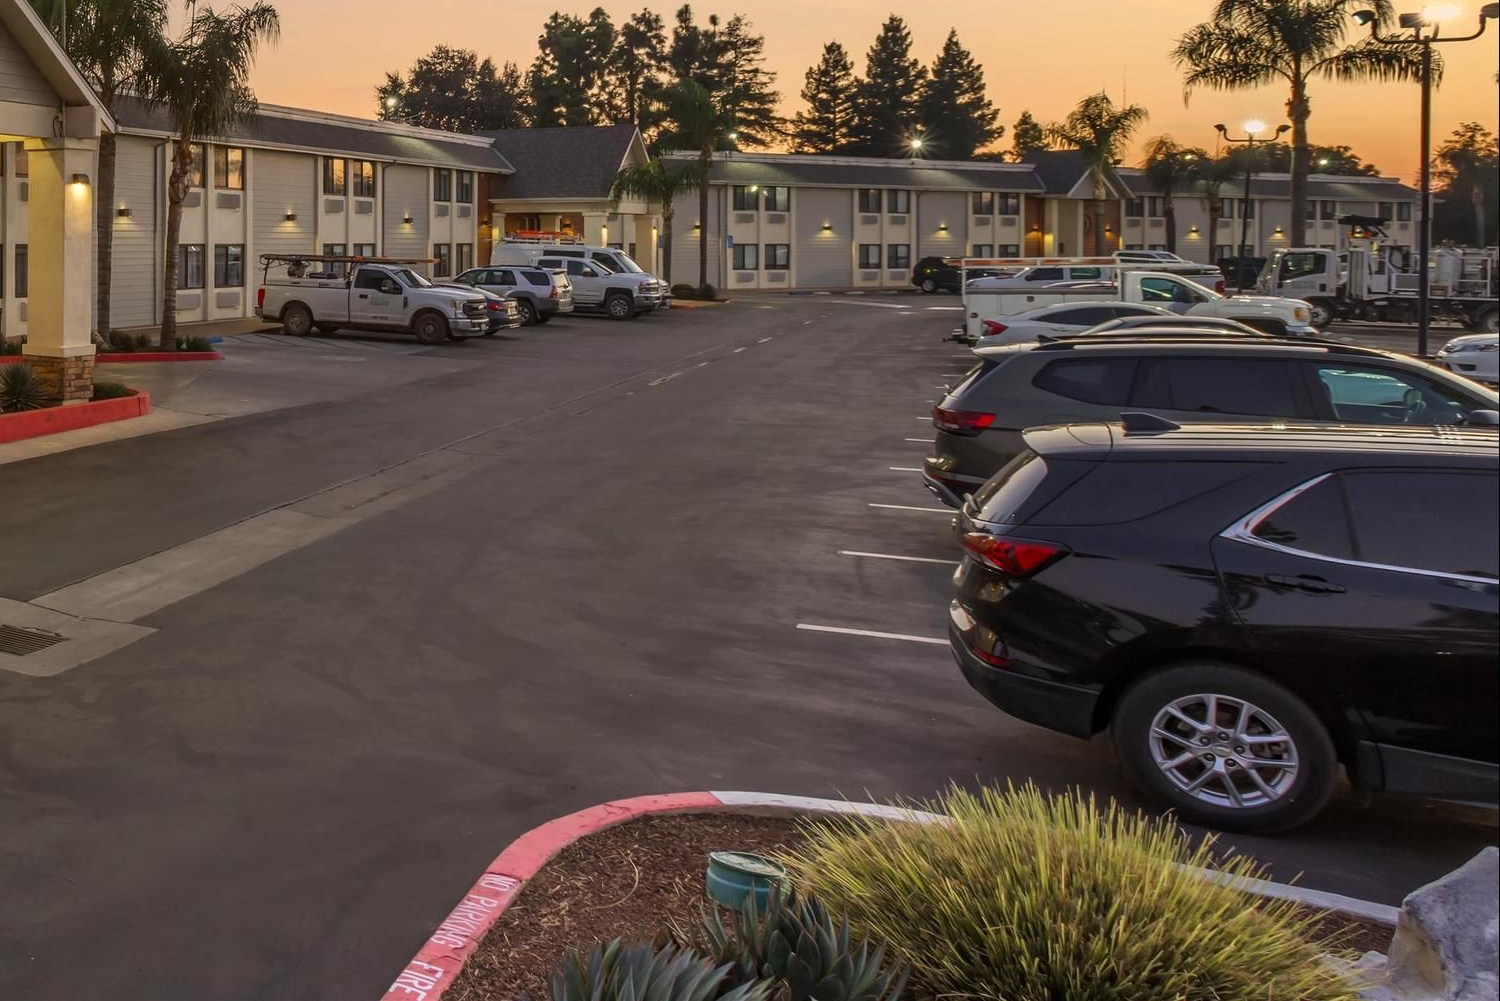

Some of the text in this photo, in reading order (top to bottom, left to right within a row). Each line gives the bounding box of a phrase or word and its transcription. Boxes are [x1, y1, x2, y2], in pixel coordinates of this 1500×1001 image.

[389, 873, 518, 1001] NO PARKING FIRE
